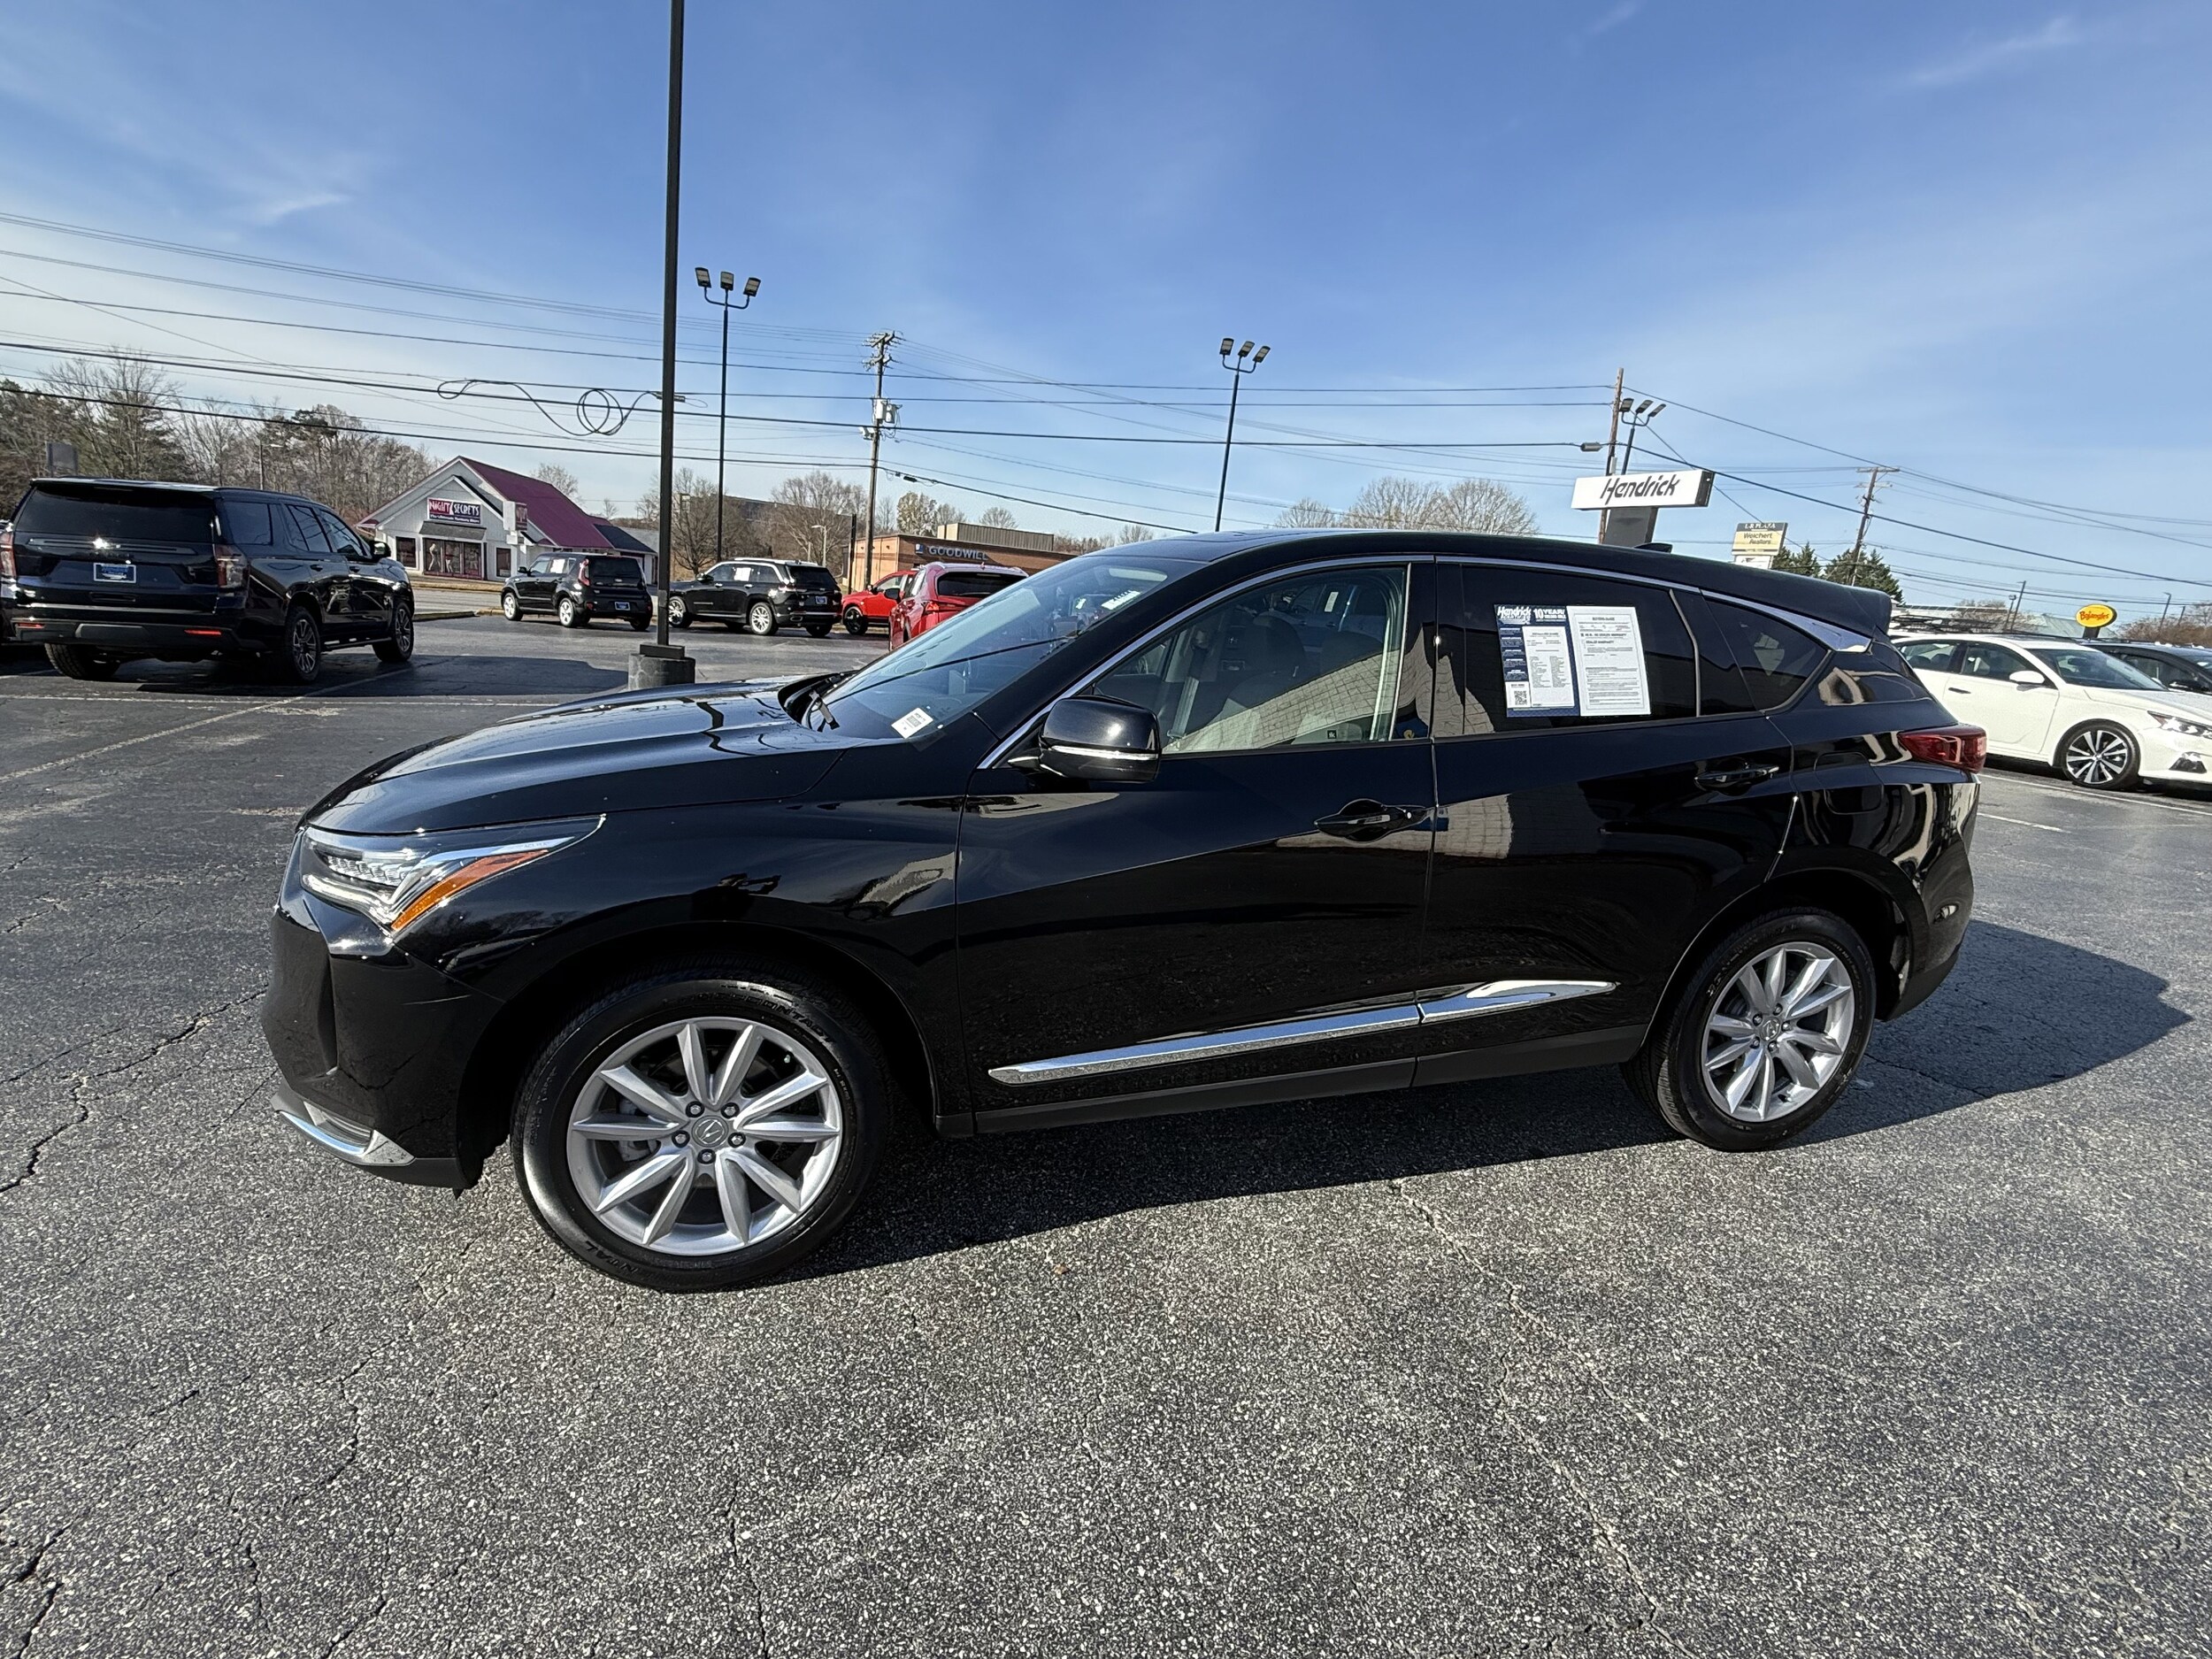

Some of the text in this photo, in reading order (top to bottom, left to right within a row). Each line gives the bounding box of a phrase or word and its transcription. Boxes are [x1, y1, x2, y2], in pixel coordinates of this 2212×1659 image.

[1600, 474, 1681, 506] Hendrick
[429, 500, 480, 516] NIGHT SECRETS
[929, 545, 988, 561] GOODWILL
[1497, 606, 1532, 619] Hendrick
[1533, 608, 1544, 619] 10
